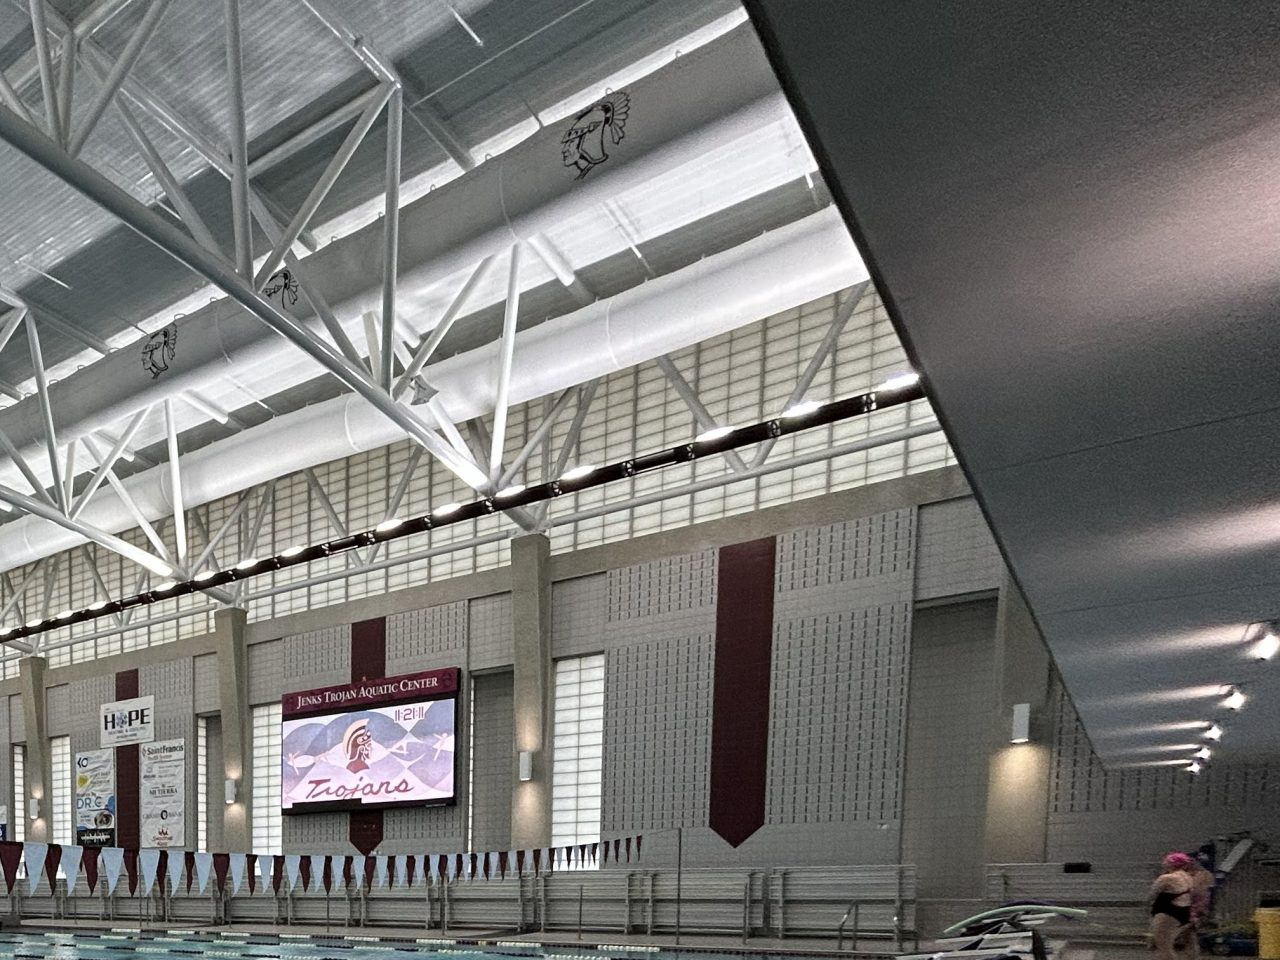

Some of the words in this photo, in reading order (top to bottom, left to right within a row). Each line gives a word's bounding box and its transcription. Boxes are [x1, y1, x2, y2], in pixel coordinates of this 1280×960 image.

[297, 694, 322, 709] JENKS
[324, 688, 357, 702] TROJAN
[358, 683, 399, 699] AQUATIC
[400, 677, 438, 692] CENTER
[305, 777, 414, 800] Trojans
